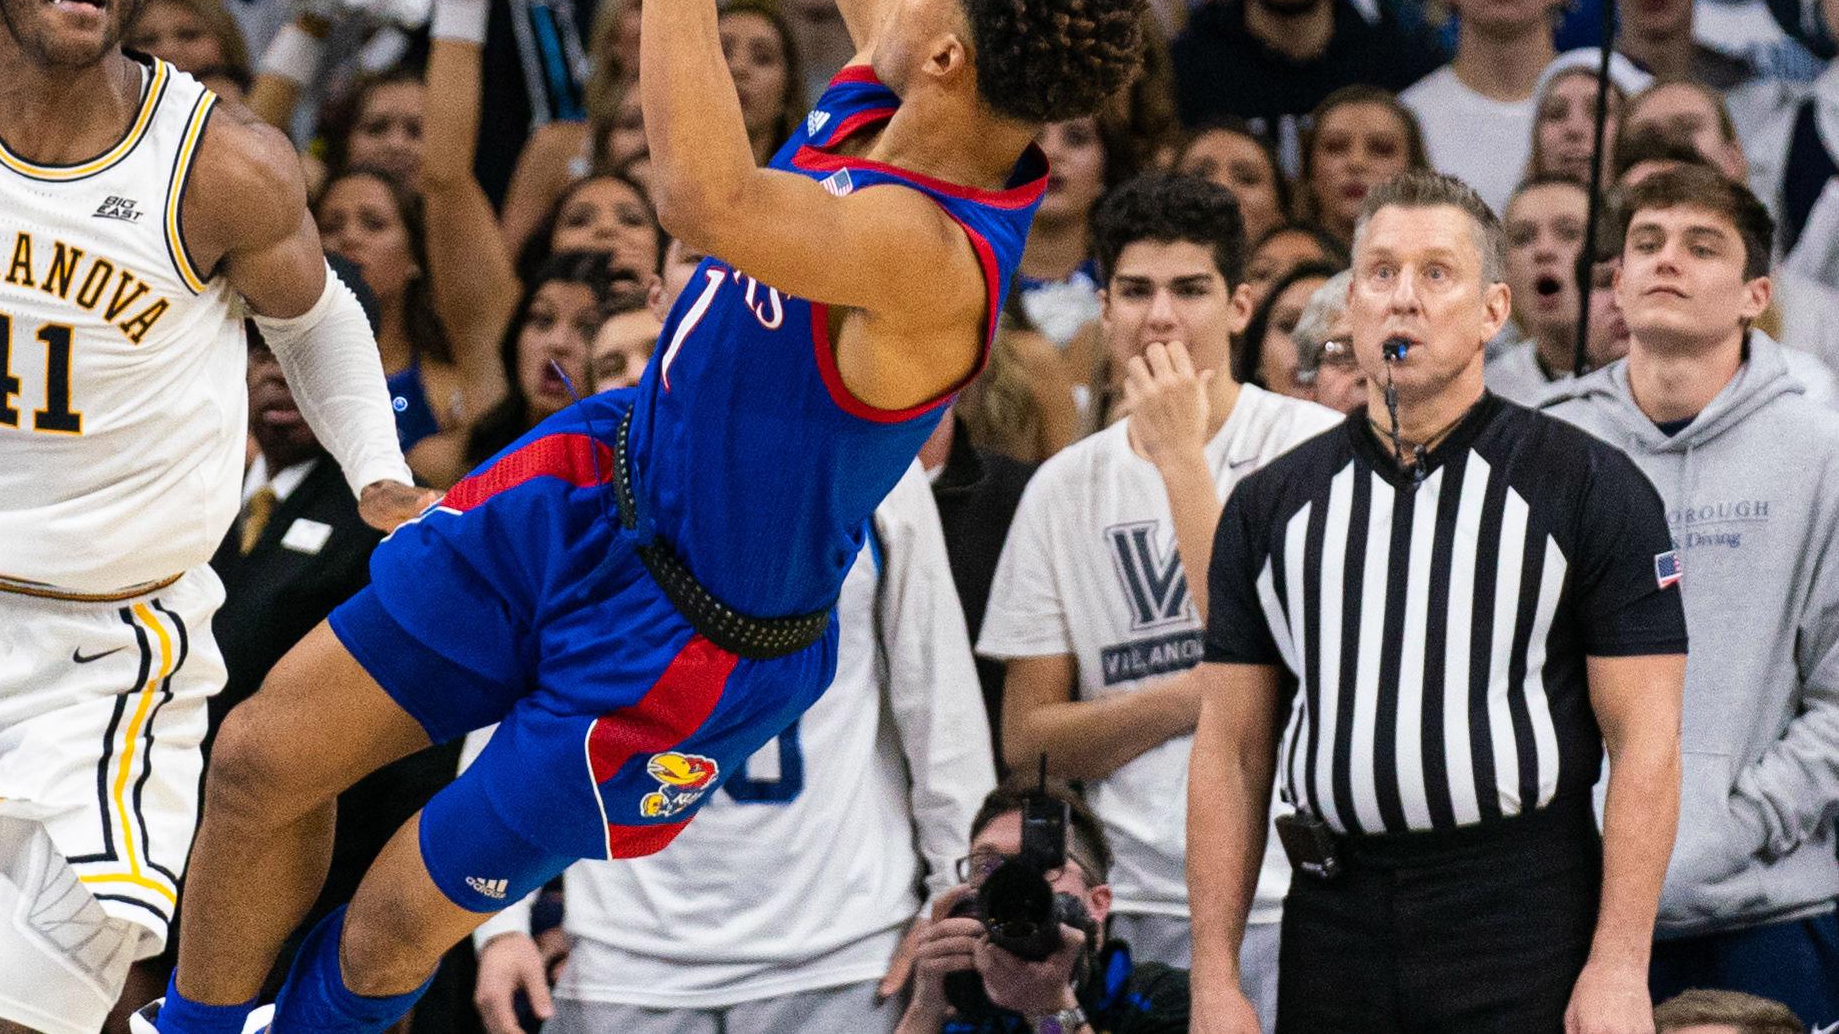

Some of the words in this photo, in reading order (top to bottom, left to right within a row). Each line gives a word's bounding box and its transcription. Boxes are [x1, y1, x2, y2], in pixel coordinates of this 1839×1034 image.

[103, 195, 138, 209] BIG
[96, 206, 144, 220] EAST
[1666, 500, 1769, 525] OROUGH
